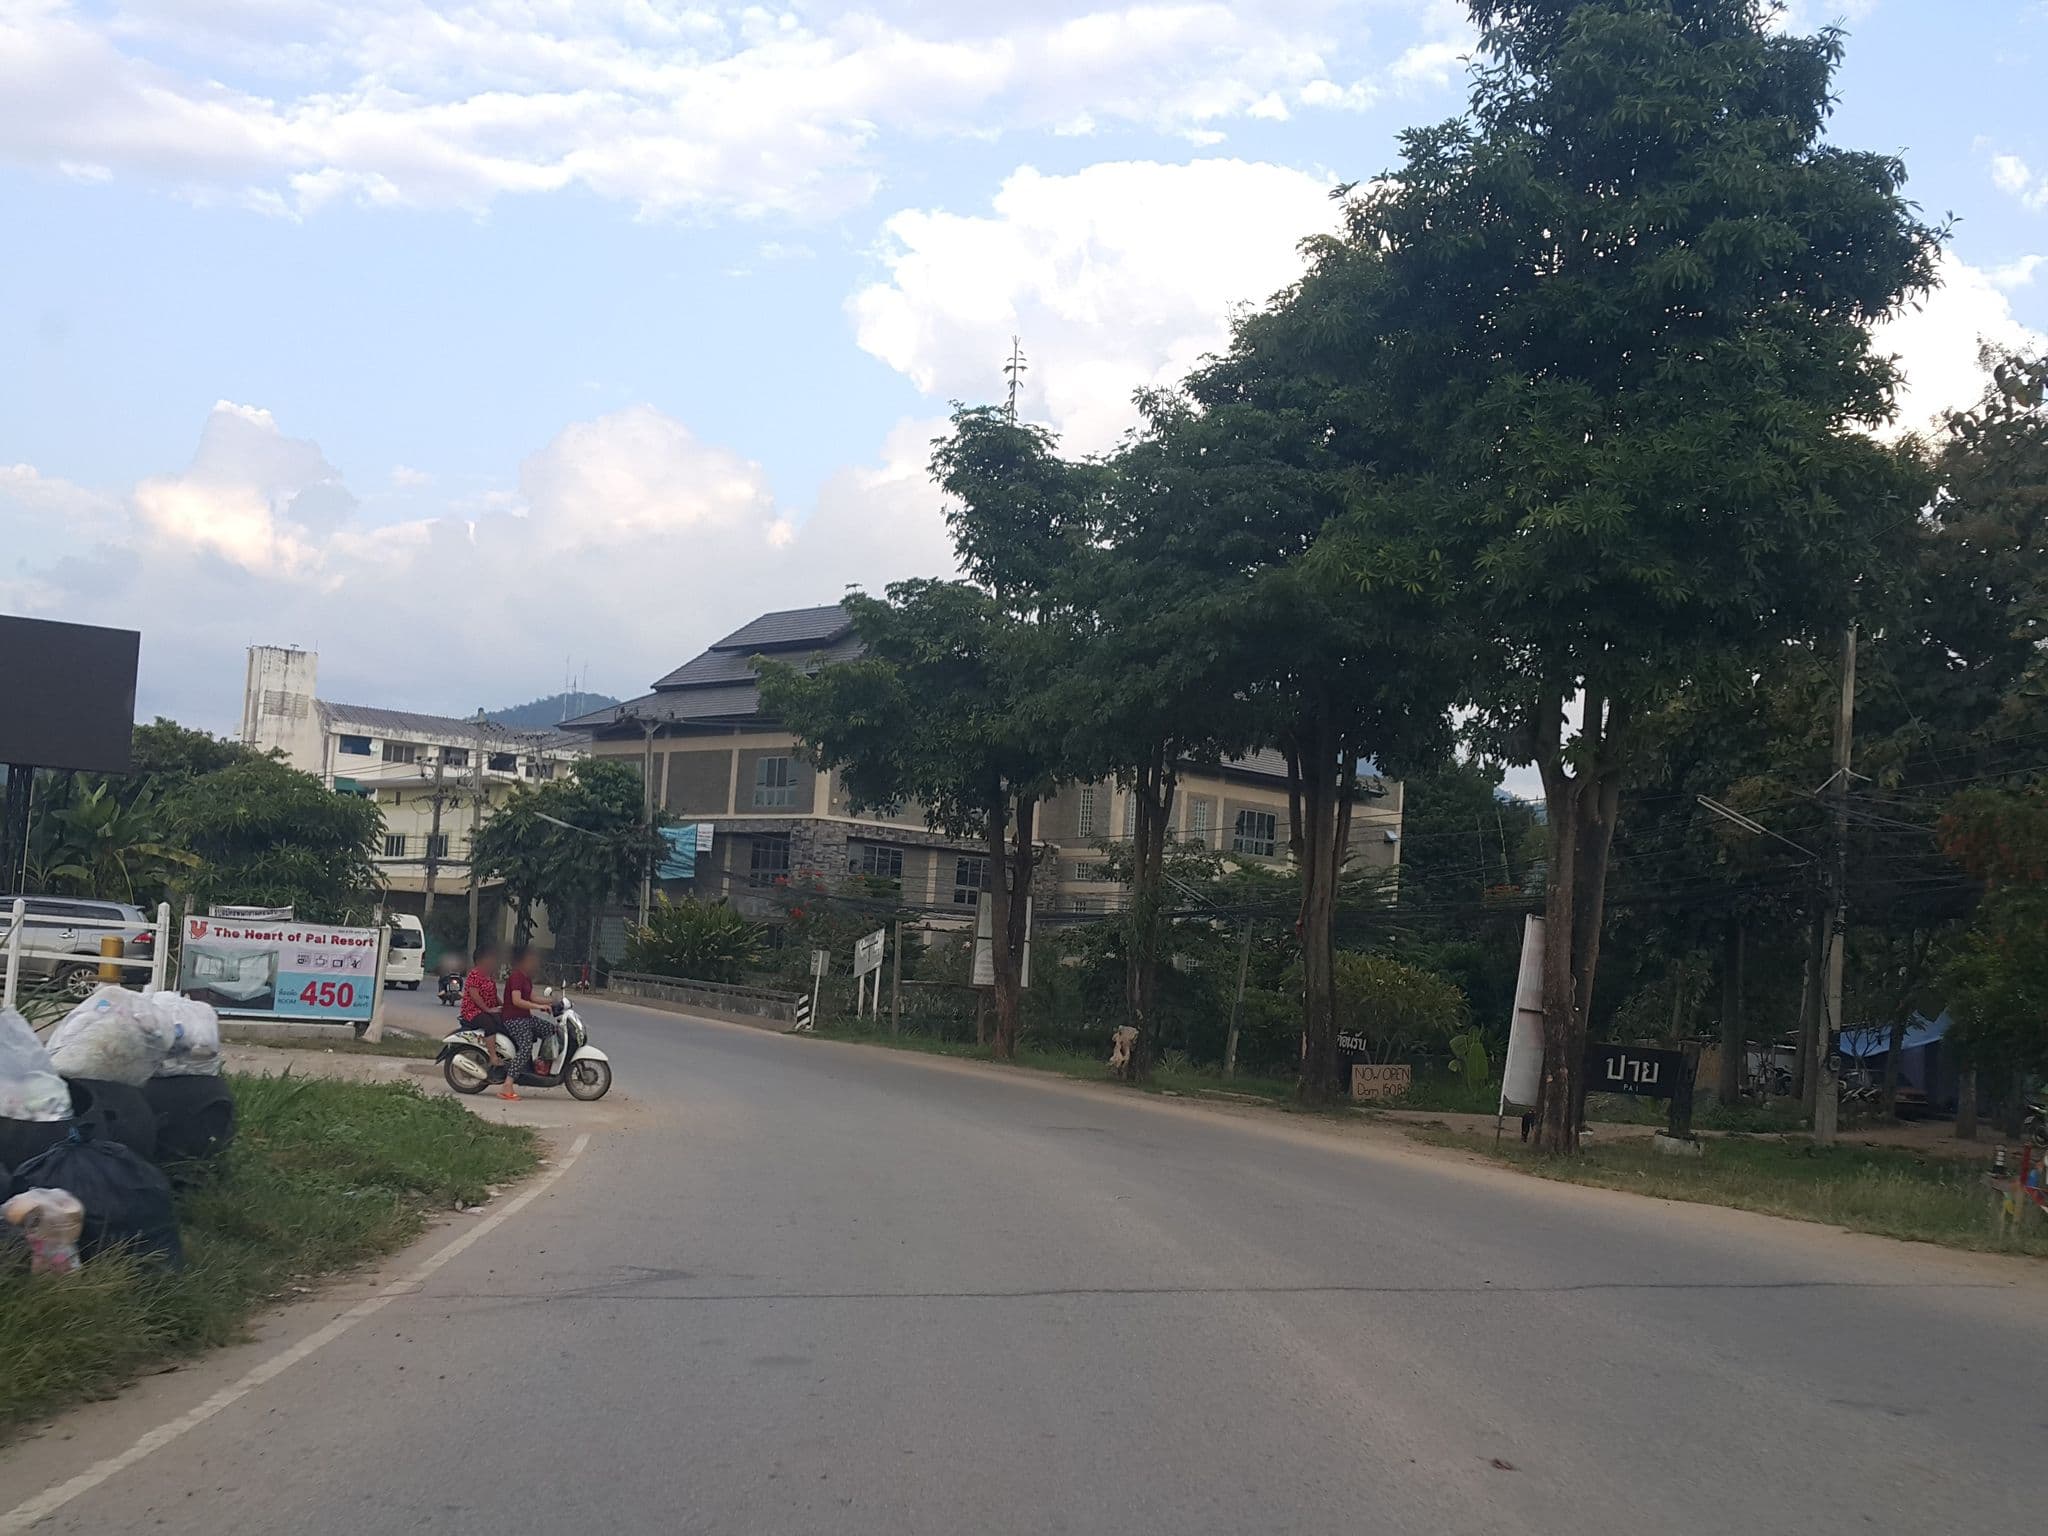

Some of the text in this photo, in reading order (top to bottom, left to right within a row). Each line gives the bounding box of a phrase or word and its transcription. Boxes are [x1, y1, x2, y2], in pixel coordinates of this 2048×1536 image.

[214, 927, 240, 938] The
[245, 929, 283, 941] Heart
[287, 932, 302, 942] of
[331, 935, 374, 947] Resort
[300, 981, 353, 1008] 450
[1355, 1067, 1410, 1081] NOW OPEN
[1606, 1054, 1660, 1083] ปาย
[1623, 1083, 1639, 1092] PAI
